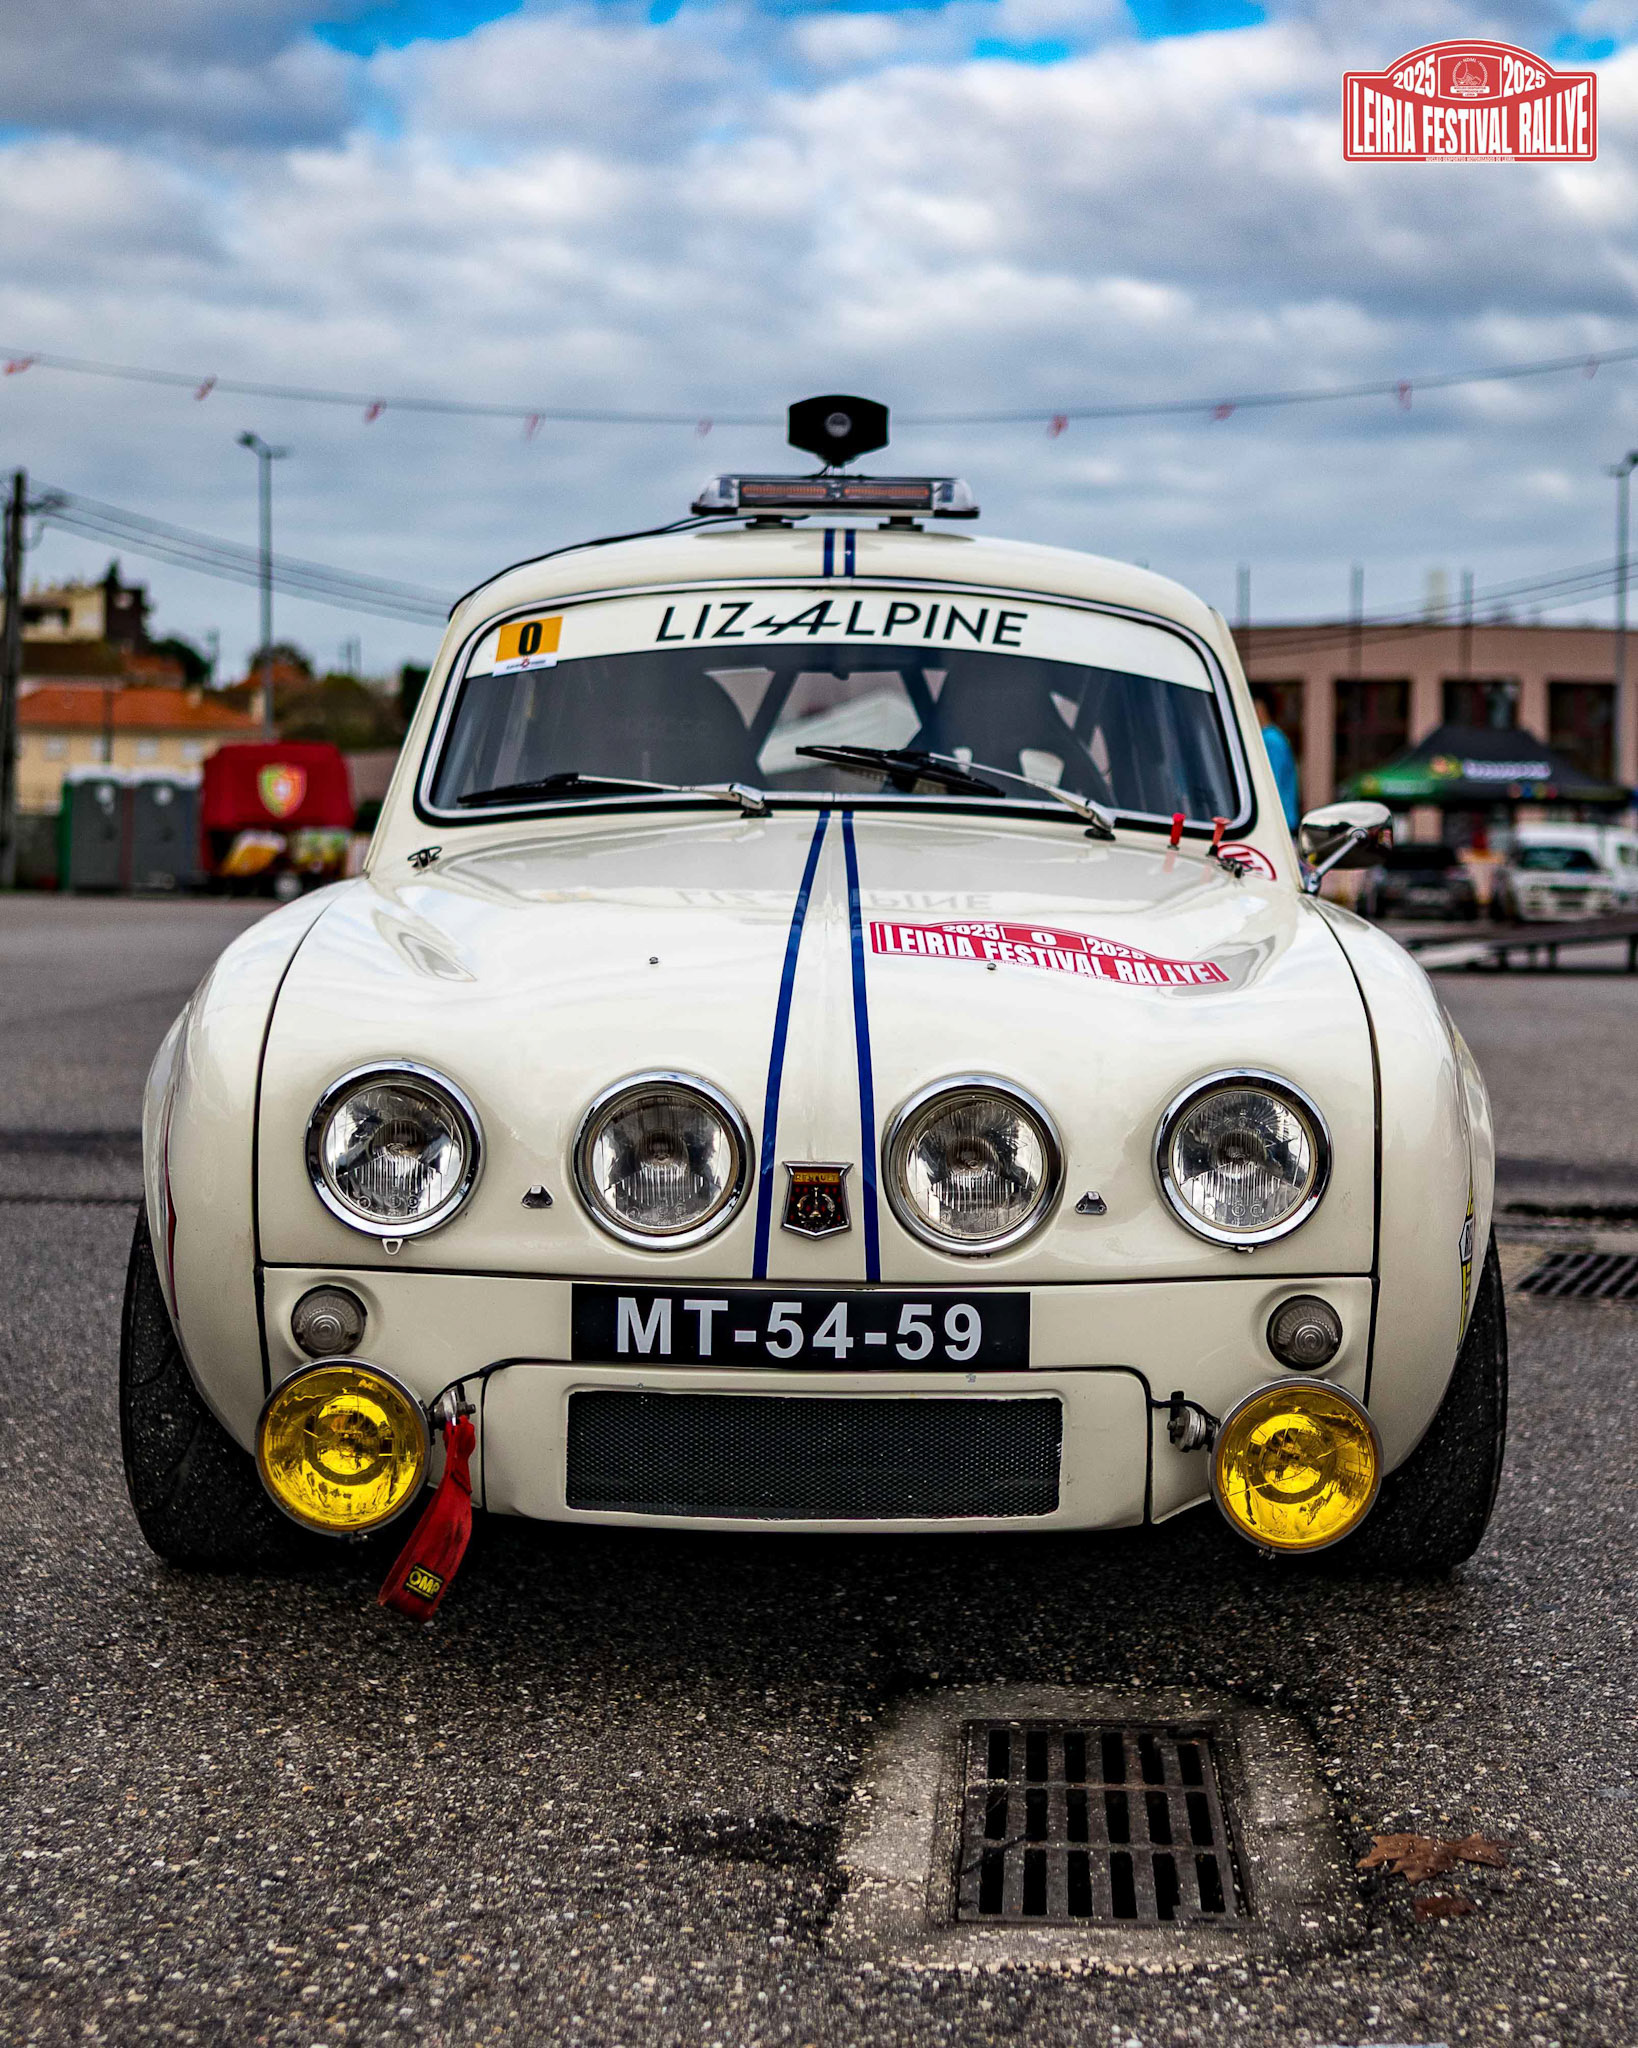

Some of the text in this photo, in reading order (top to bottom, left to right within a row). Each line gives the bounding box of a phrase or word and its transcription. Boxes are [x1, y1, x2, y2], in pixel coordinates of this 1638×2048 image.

[518, 622, 543, 656] 0
[942, 923, 1000, 941] 2025
[1030, 931, 1058, 946] 0
[884, 924, 981, 958] LEIRIA
[984, 938, 1111, 980] FESTIVAL
[1114, 959, 1217, 985] RALLYE
[616, 1296, 983, 1361] MT-54-59
[409, 1570, 441, 1595] OMP
